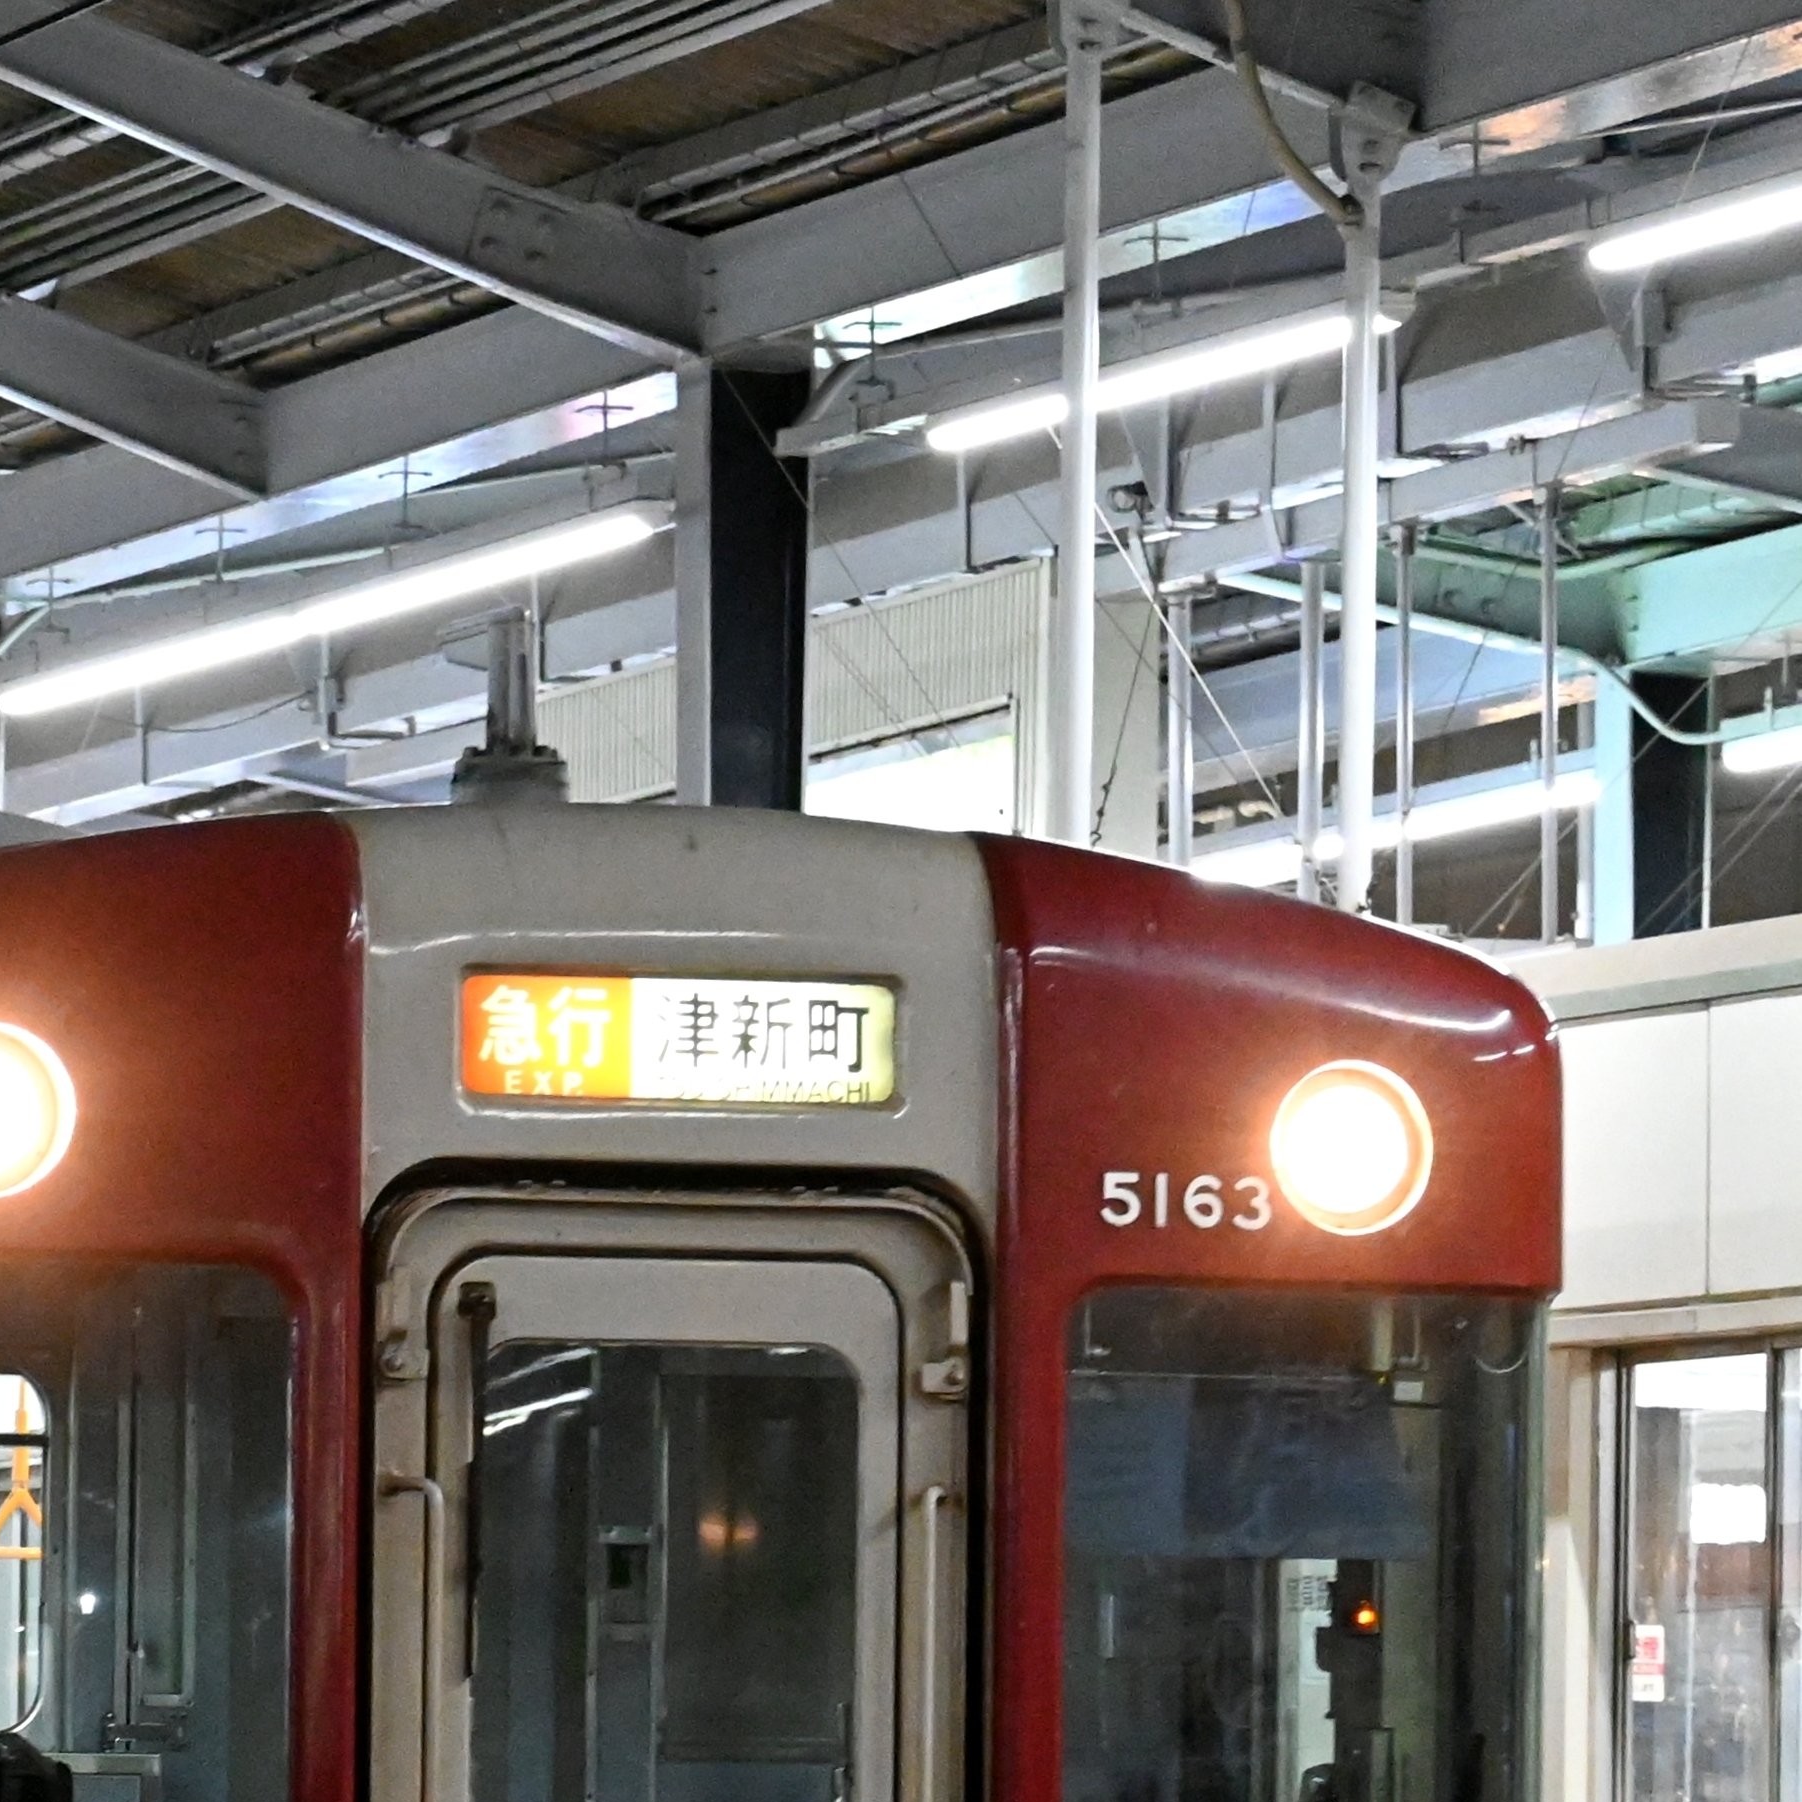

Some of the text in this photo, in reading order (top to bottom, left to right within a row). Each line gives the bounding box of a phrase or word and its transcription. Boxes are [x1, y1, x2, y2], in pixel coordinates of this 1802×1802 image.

[480, 983, 611, 1067] 急行
[658, 992, 870, 1073] 津新町
[1099, 1171, 1274, 1231] 5163
